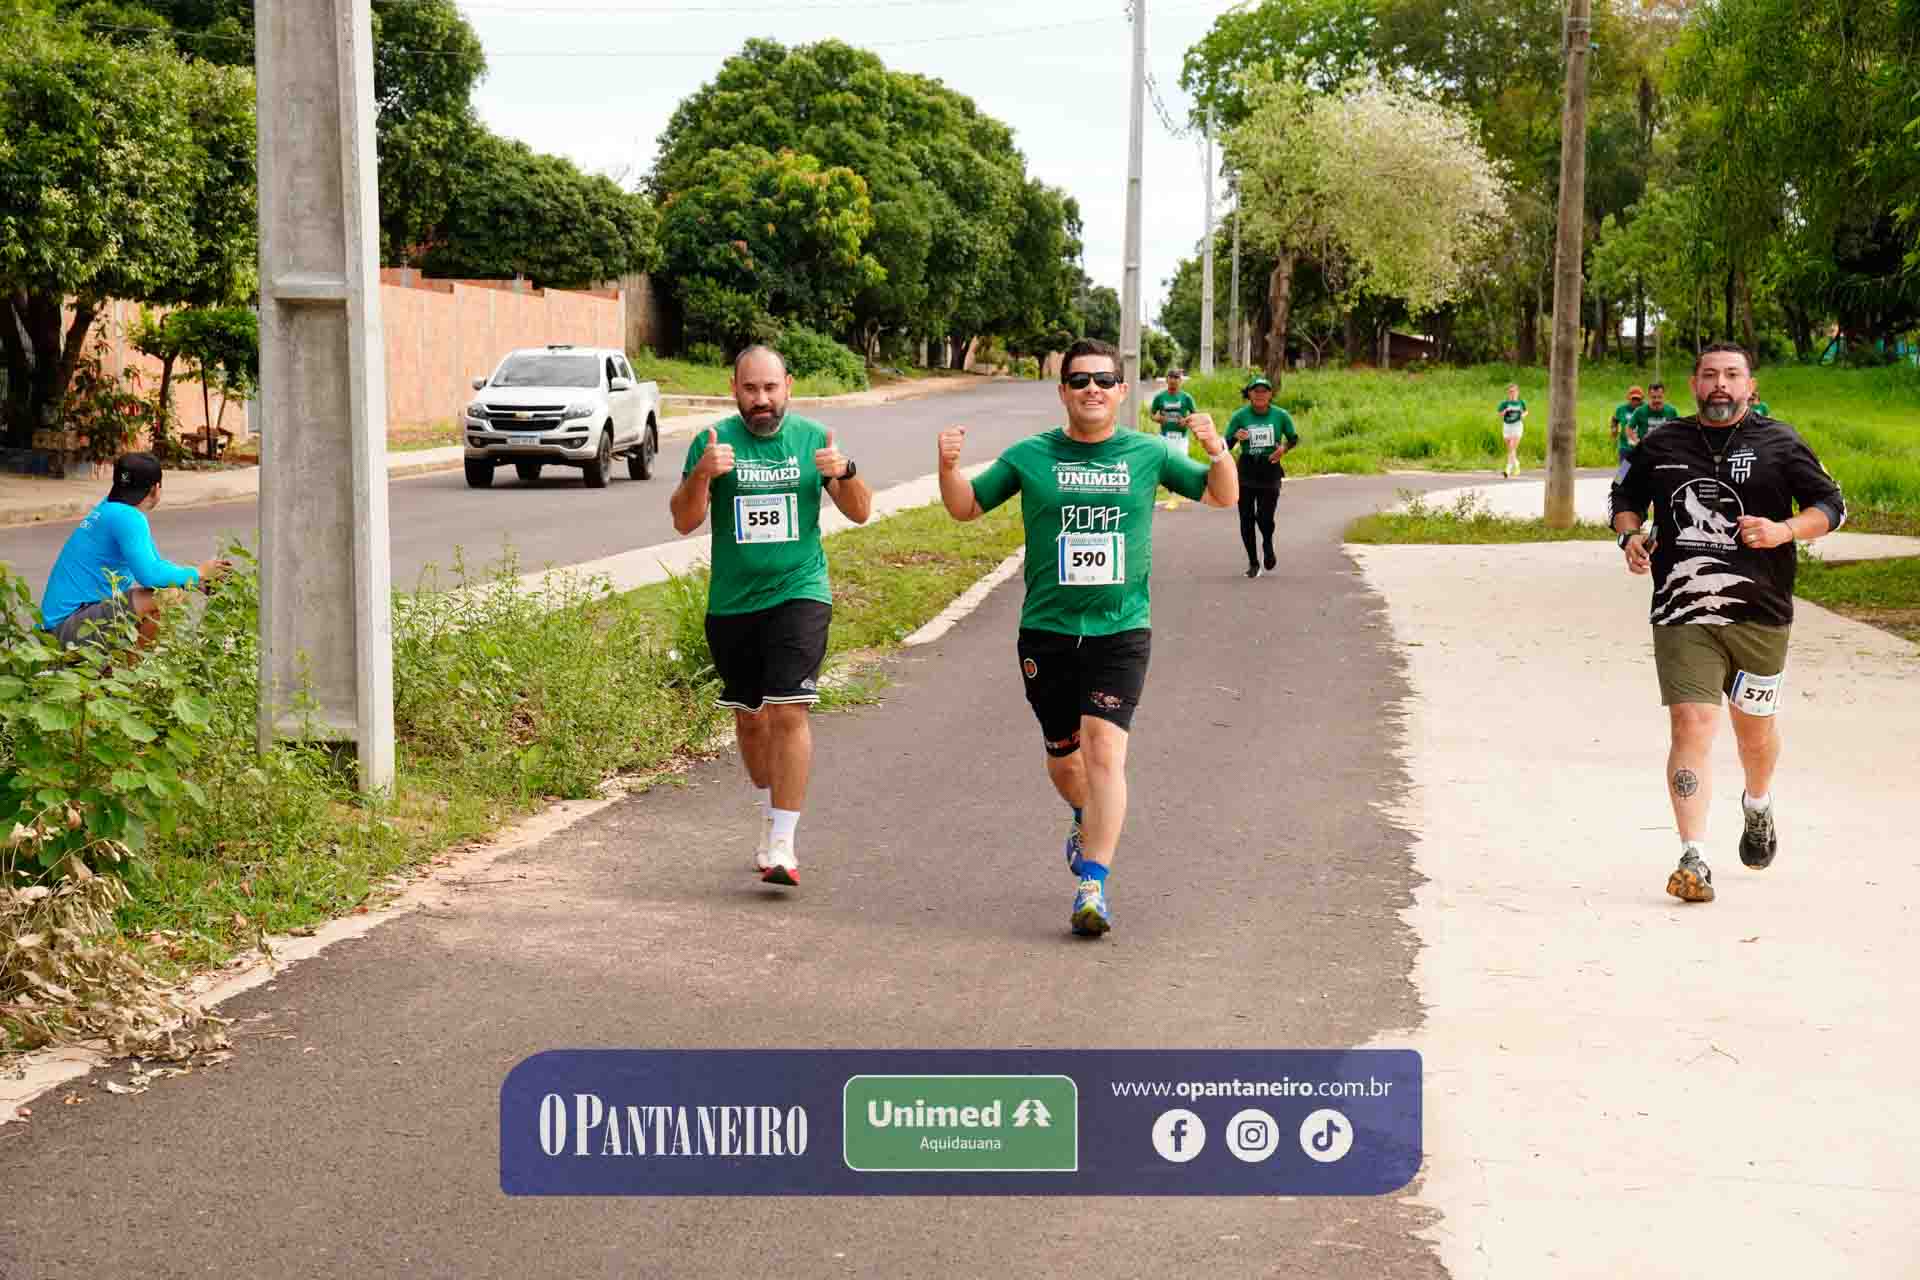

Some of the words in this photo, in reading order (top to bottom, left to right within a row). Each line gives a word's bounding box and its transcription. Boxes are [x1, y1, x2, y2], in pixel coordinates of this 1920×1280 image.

[736, 467, 800, 481] UNIMED
[1058, 472, 1130, 485] UNIMED
[749, 511, 779, 525] 558
[1073, 552, 1105, 566] 590
[1744, 688, 1773, 701] 570
